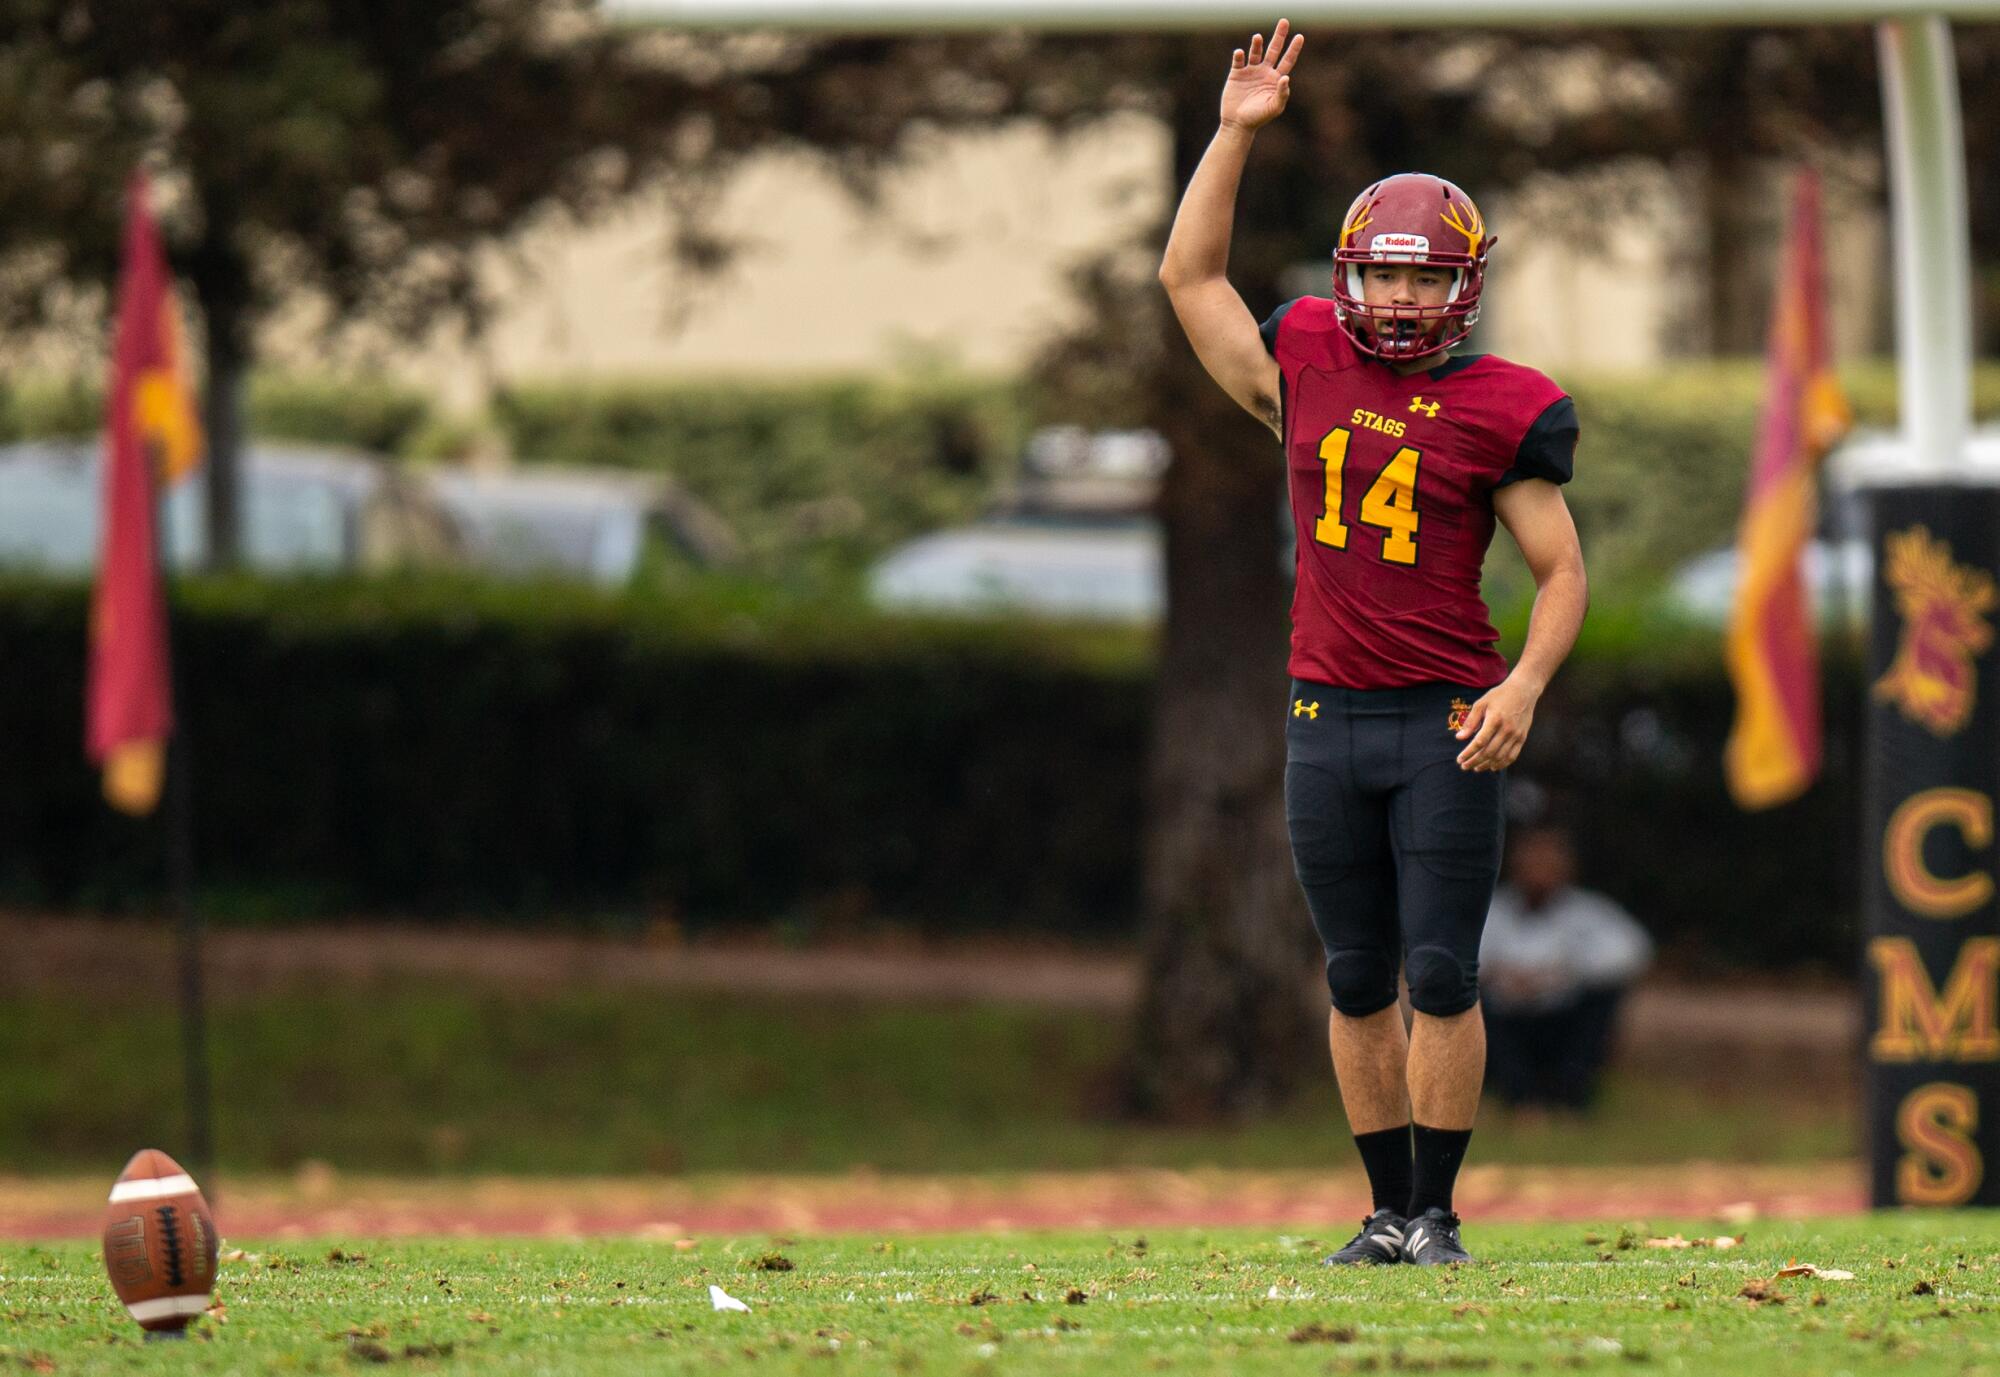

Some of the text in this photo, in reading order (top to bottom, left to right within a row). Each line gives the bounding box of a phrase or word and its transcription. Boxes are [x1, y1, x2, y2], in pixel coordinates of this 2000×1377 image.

[1385, 237, 1416, 246] Riddell
[1351, 408, 1407, 438] STAGS
[1315, 425, 1423, 568] 14
